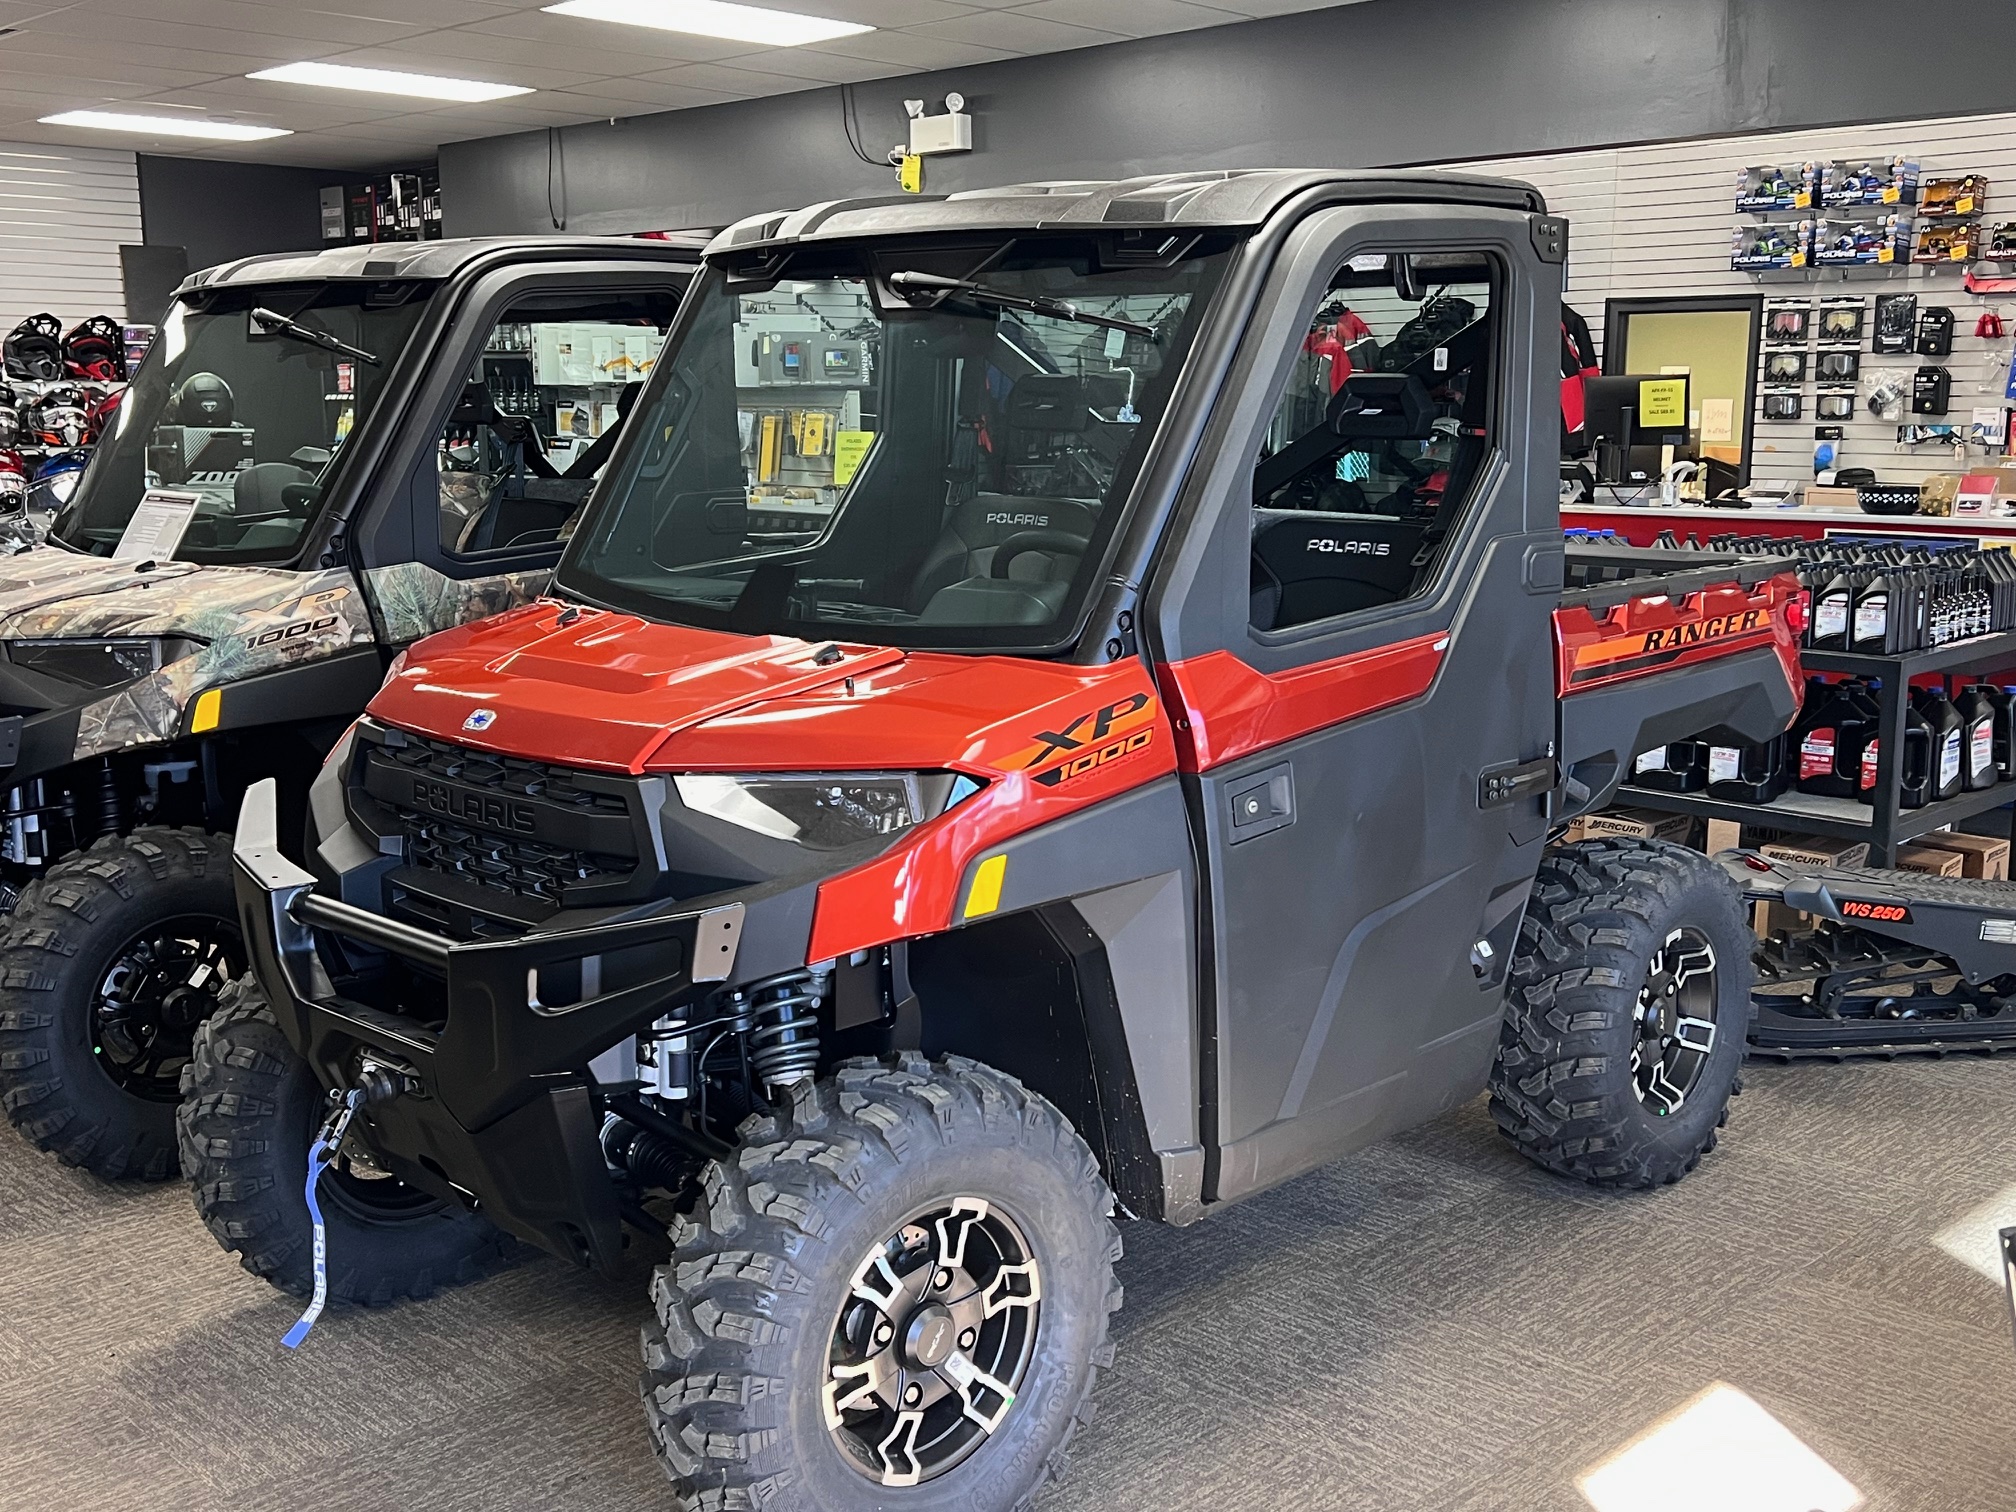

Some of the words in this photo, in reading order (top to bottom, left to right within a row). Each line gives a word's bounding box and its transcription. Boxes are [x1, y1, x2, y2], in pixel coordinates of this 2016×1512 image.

[1737, 196, 1776, 206] POLARIS
[1822, 190, 1864, 200] POLARIS
[1733, 255, 1771, 264] POLARIS
[1816, 250, 1857, 259] POLARIS
[860, 341, 870, 385] GARMIN
[986, 512, 1049, 527] POLARIS
[1306, 539, 1390, 556] POLARIS
[232, 585, 353, 636] XP
[245, 614, 340, 650] 1000
[1642, 609, 1760, 653] RANGER
[1021, 692, 1150, 770] XP
[1059, 727, 1155, 782] 1000
[412, 780, 537, 835] POLARIS
[1587, 819, 1644, 835] MERCURY
[1768, 850, 1829, 866] MERCURY
[301, 1223, 326, 1325] POLARIS
